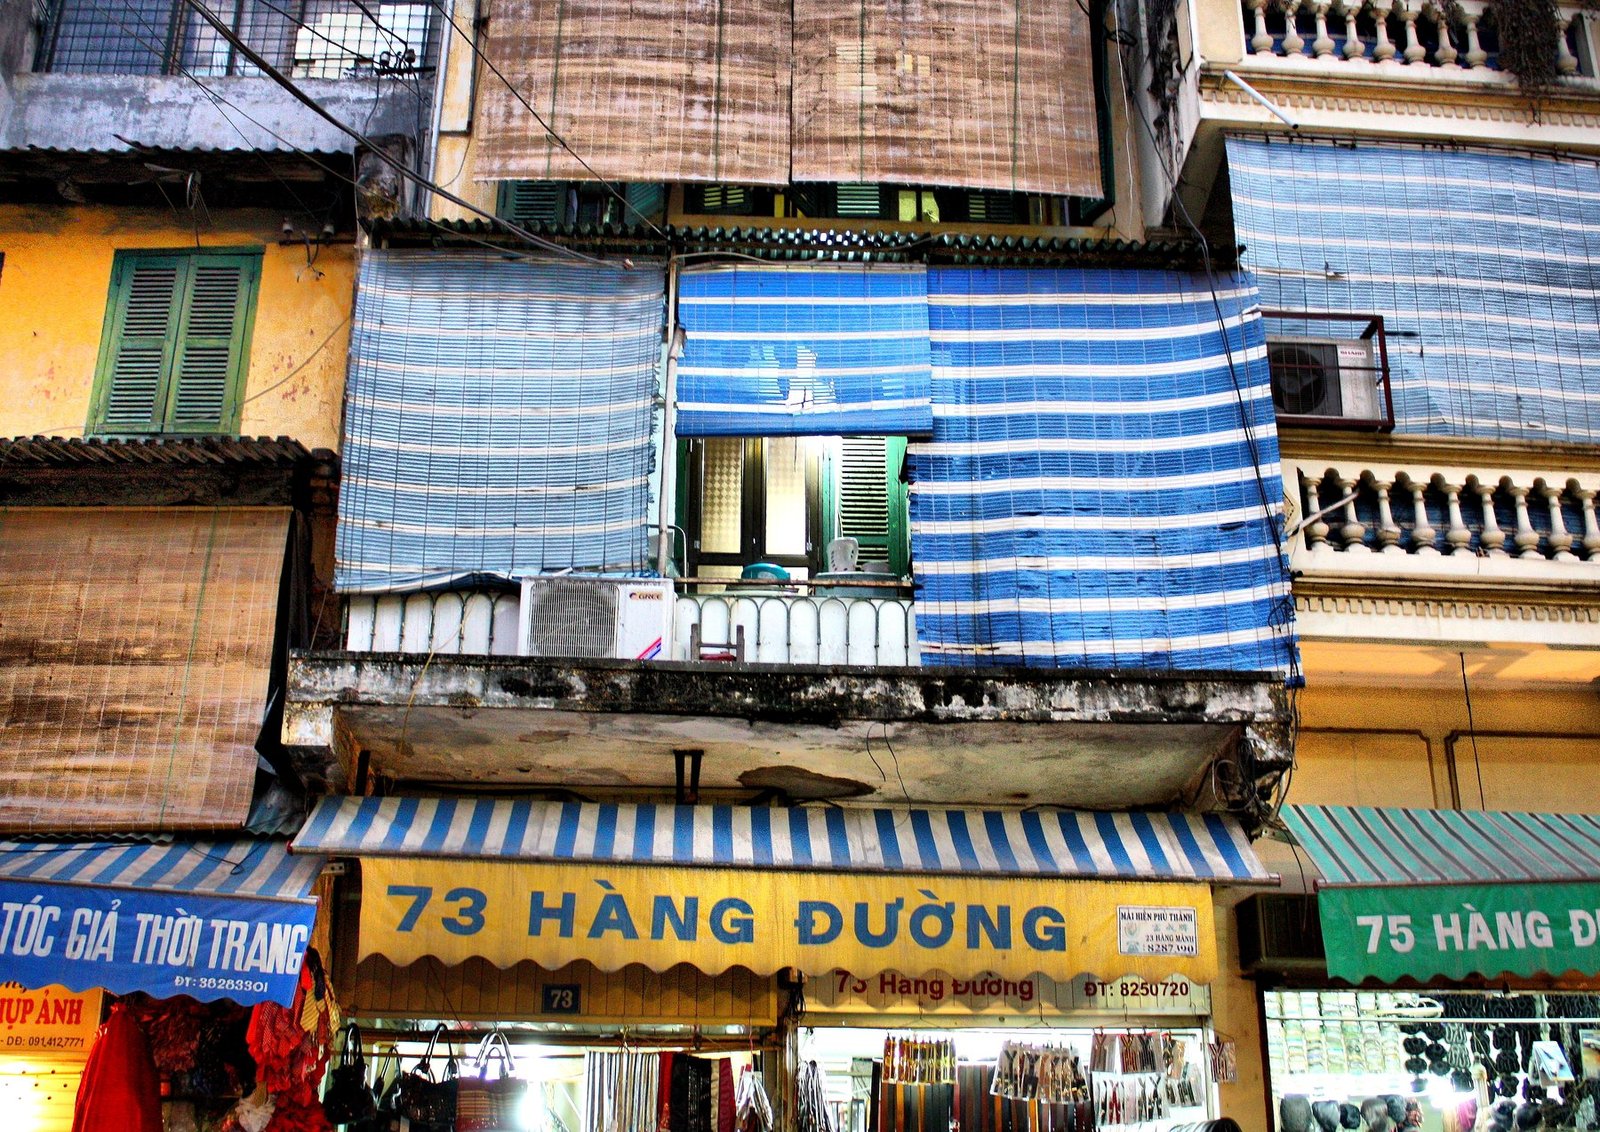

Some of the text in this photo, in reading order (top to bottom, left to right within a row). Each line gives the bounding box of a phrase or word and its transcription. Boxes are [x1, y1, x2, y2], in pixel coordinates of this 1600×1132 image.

[0, 894, 308, 975] TÓC GIẢ THỜI TRANG
[386, 879, 1067, 952] 73 HÀNG ĐƯỜNG
[1357, 902, 1600, 954] 75 HÀNG Đ
[35, 988, 84, 1025] ẢNH
[549, 988, 574, 1009] 73
[1084, 981, 1189, 997] ĐT: 8250720
